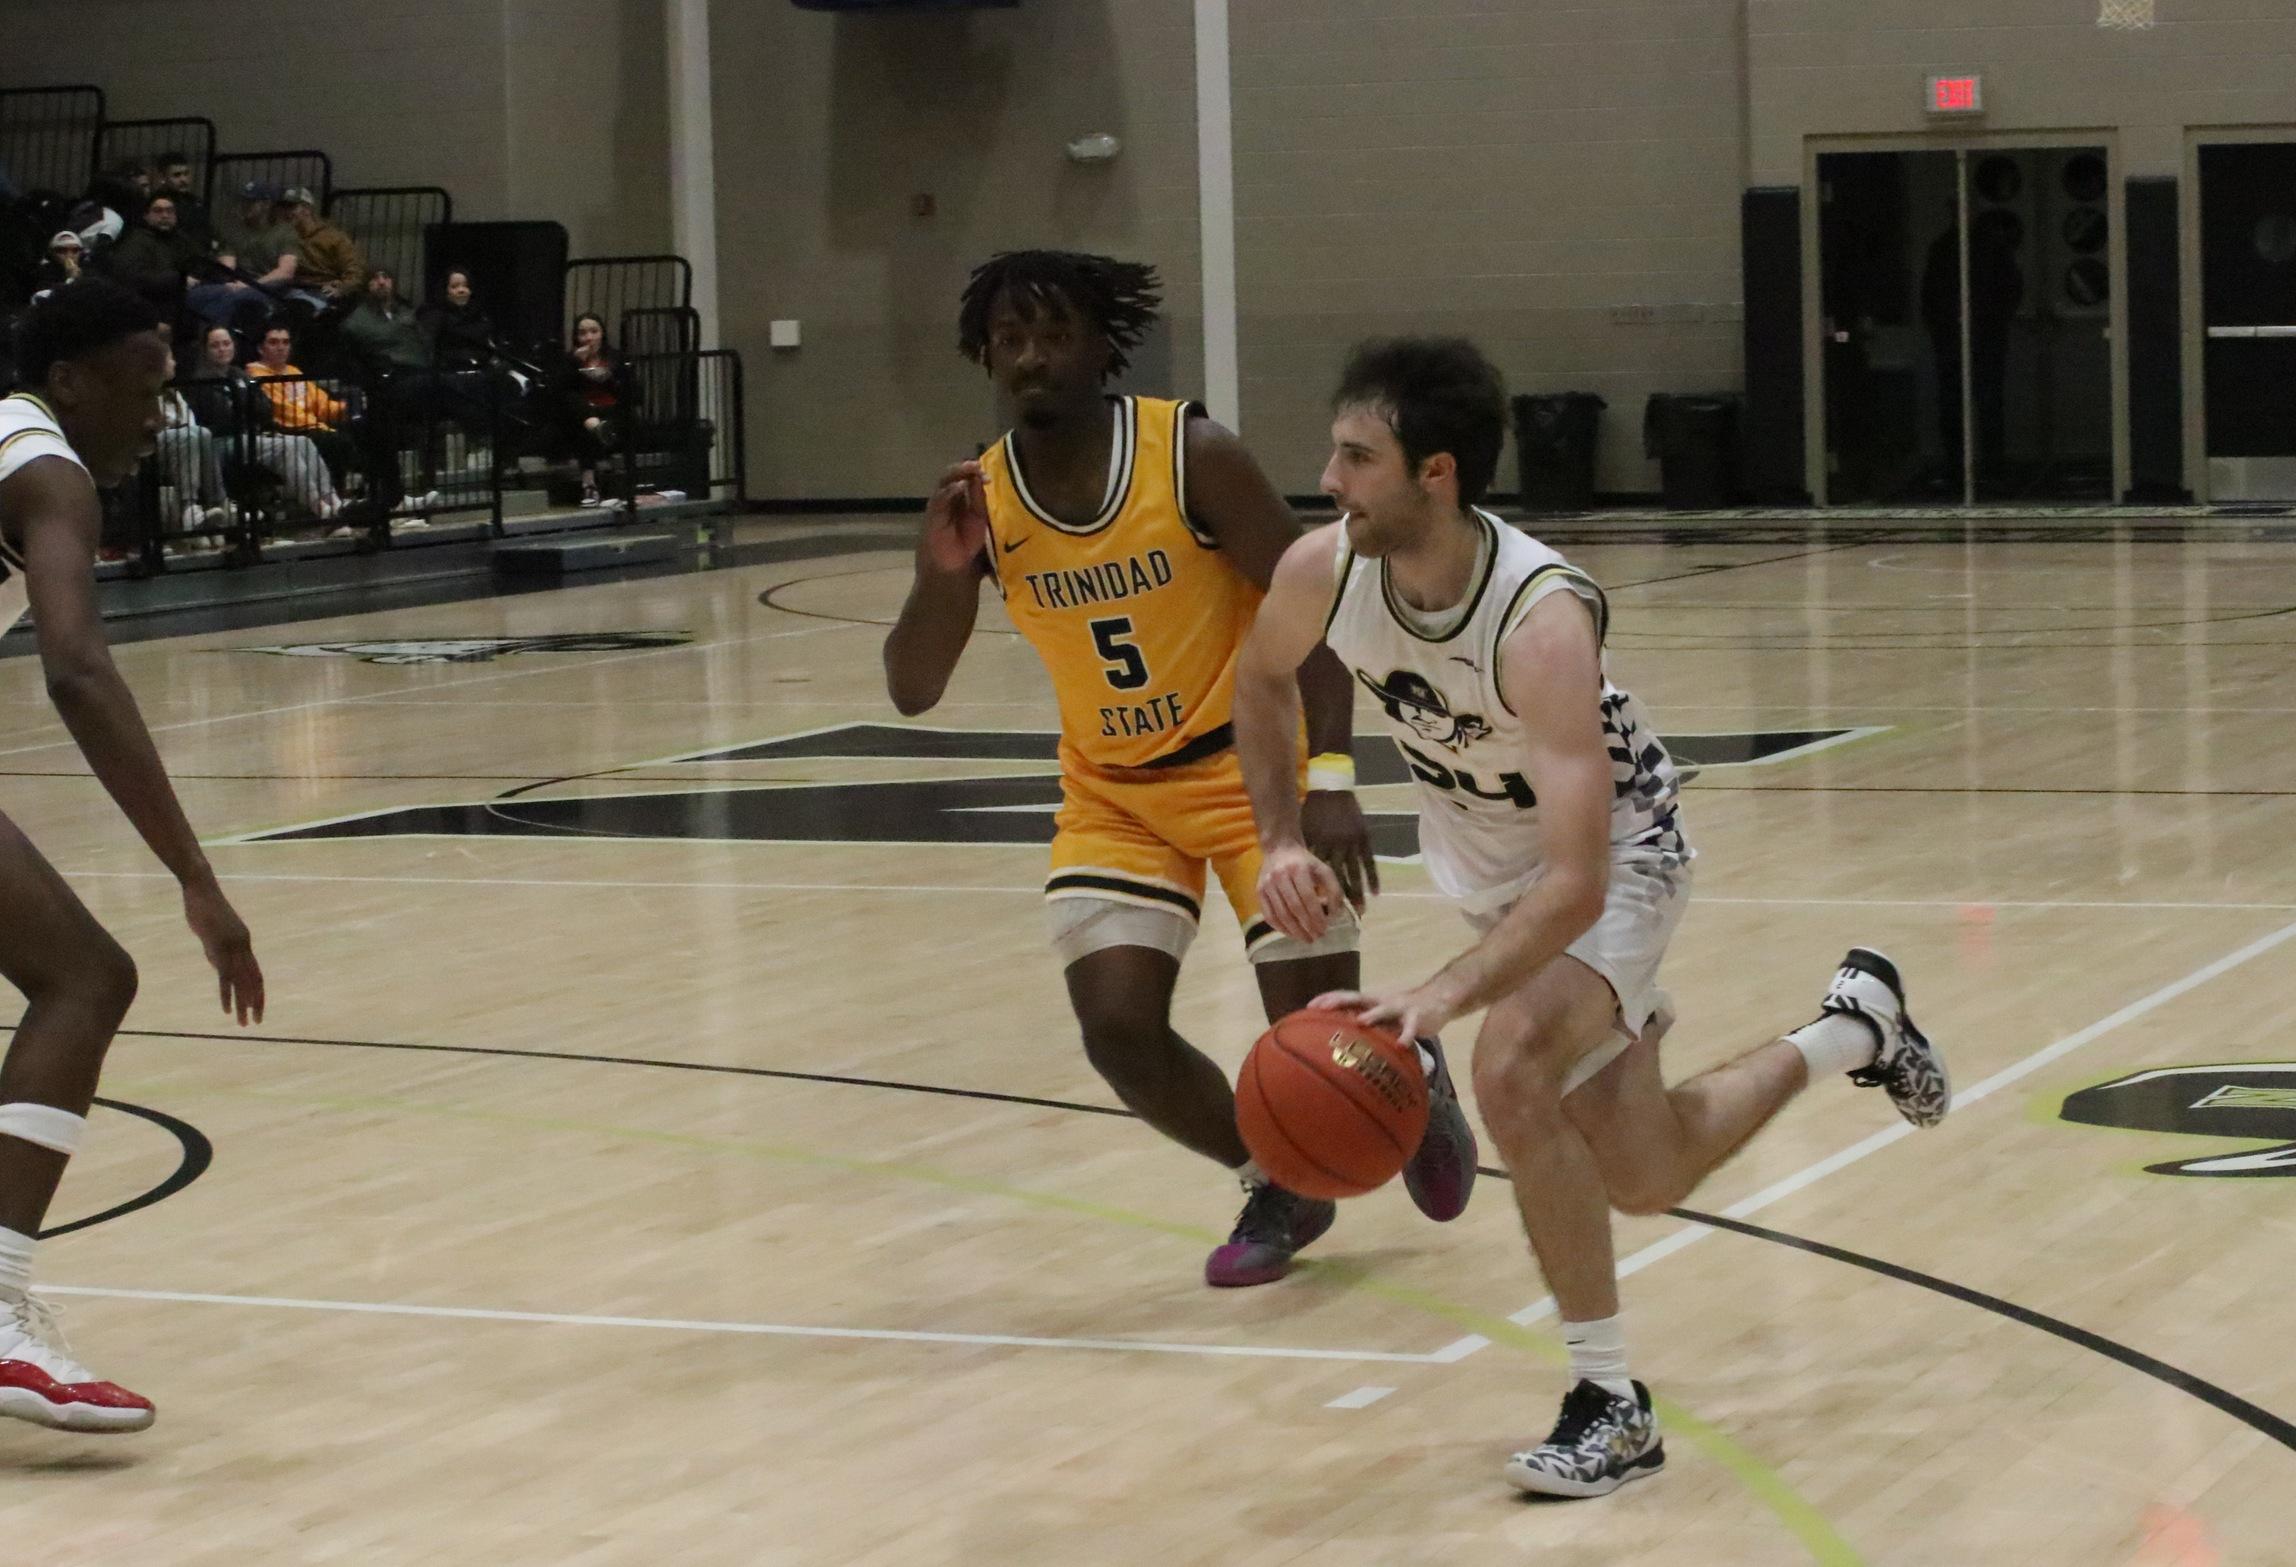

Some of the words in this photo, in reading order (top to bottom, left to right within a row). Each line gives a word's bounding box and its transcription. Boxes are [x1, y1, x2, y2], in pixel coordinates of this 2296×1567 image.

[1935, 79, 1974, 109] EXIT
[1025, 549, 1173, 609] TRINIDAD
[1089, 615, 1150, 691] 5
[1100, 693, 1185, 737] STATE
